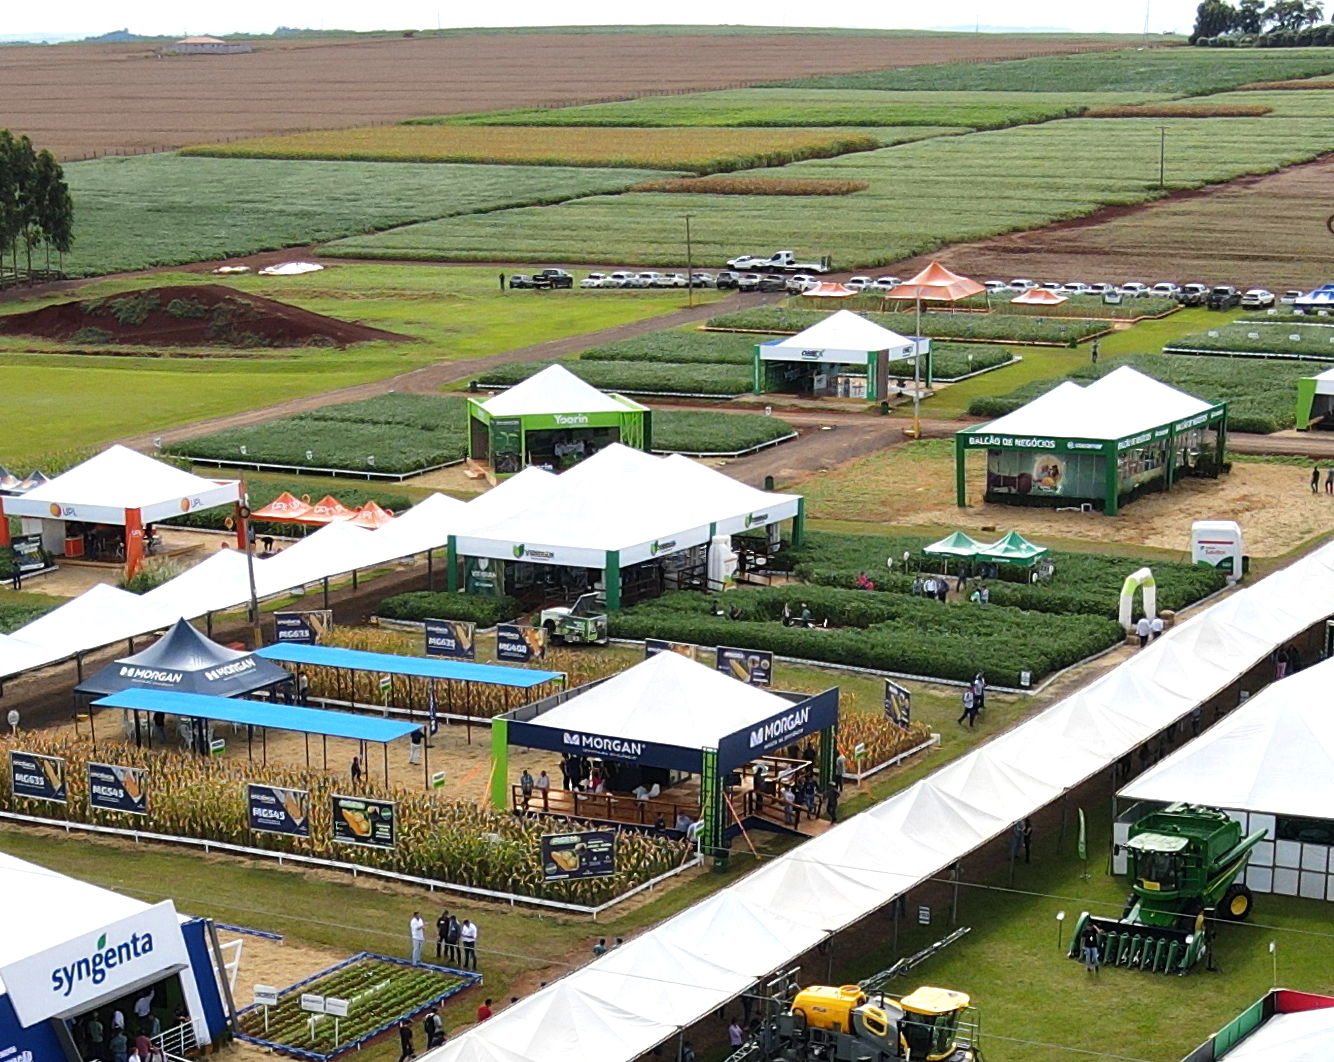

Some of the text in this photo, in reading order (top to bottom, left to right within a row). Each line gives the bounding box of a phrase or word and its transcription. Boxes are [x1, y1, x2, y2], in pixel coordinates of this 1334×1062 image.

[135, 668, 183, 683] MORGAN
[764, 706, 809, 741] MORGAN
[582, 735, 642, 755] MORGAN
[51, 931, 155, 996] syngenta
